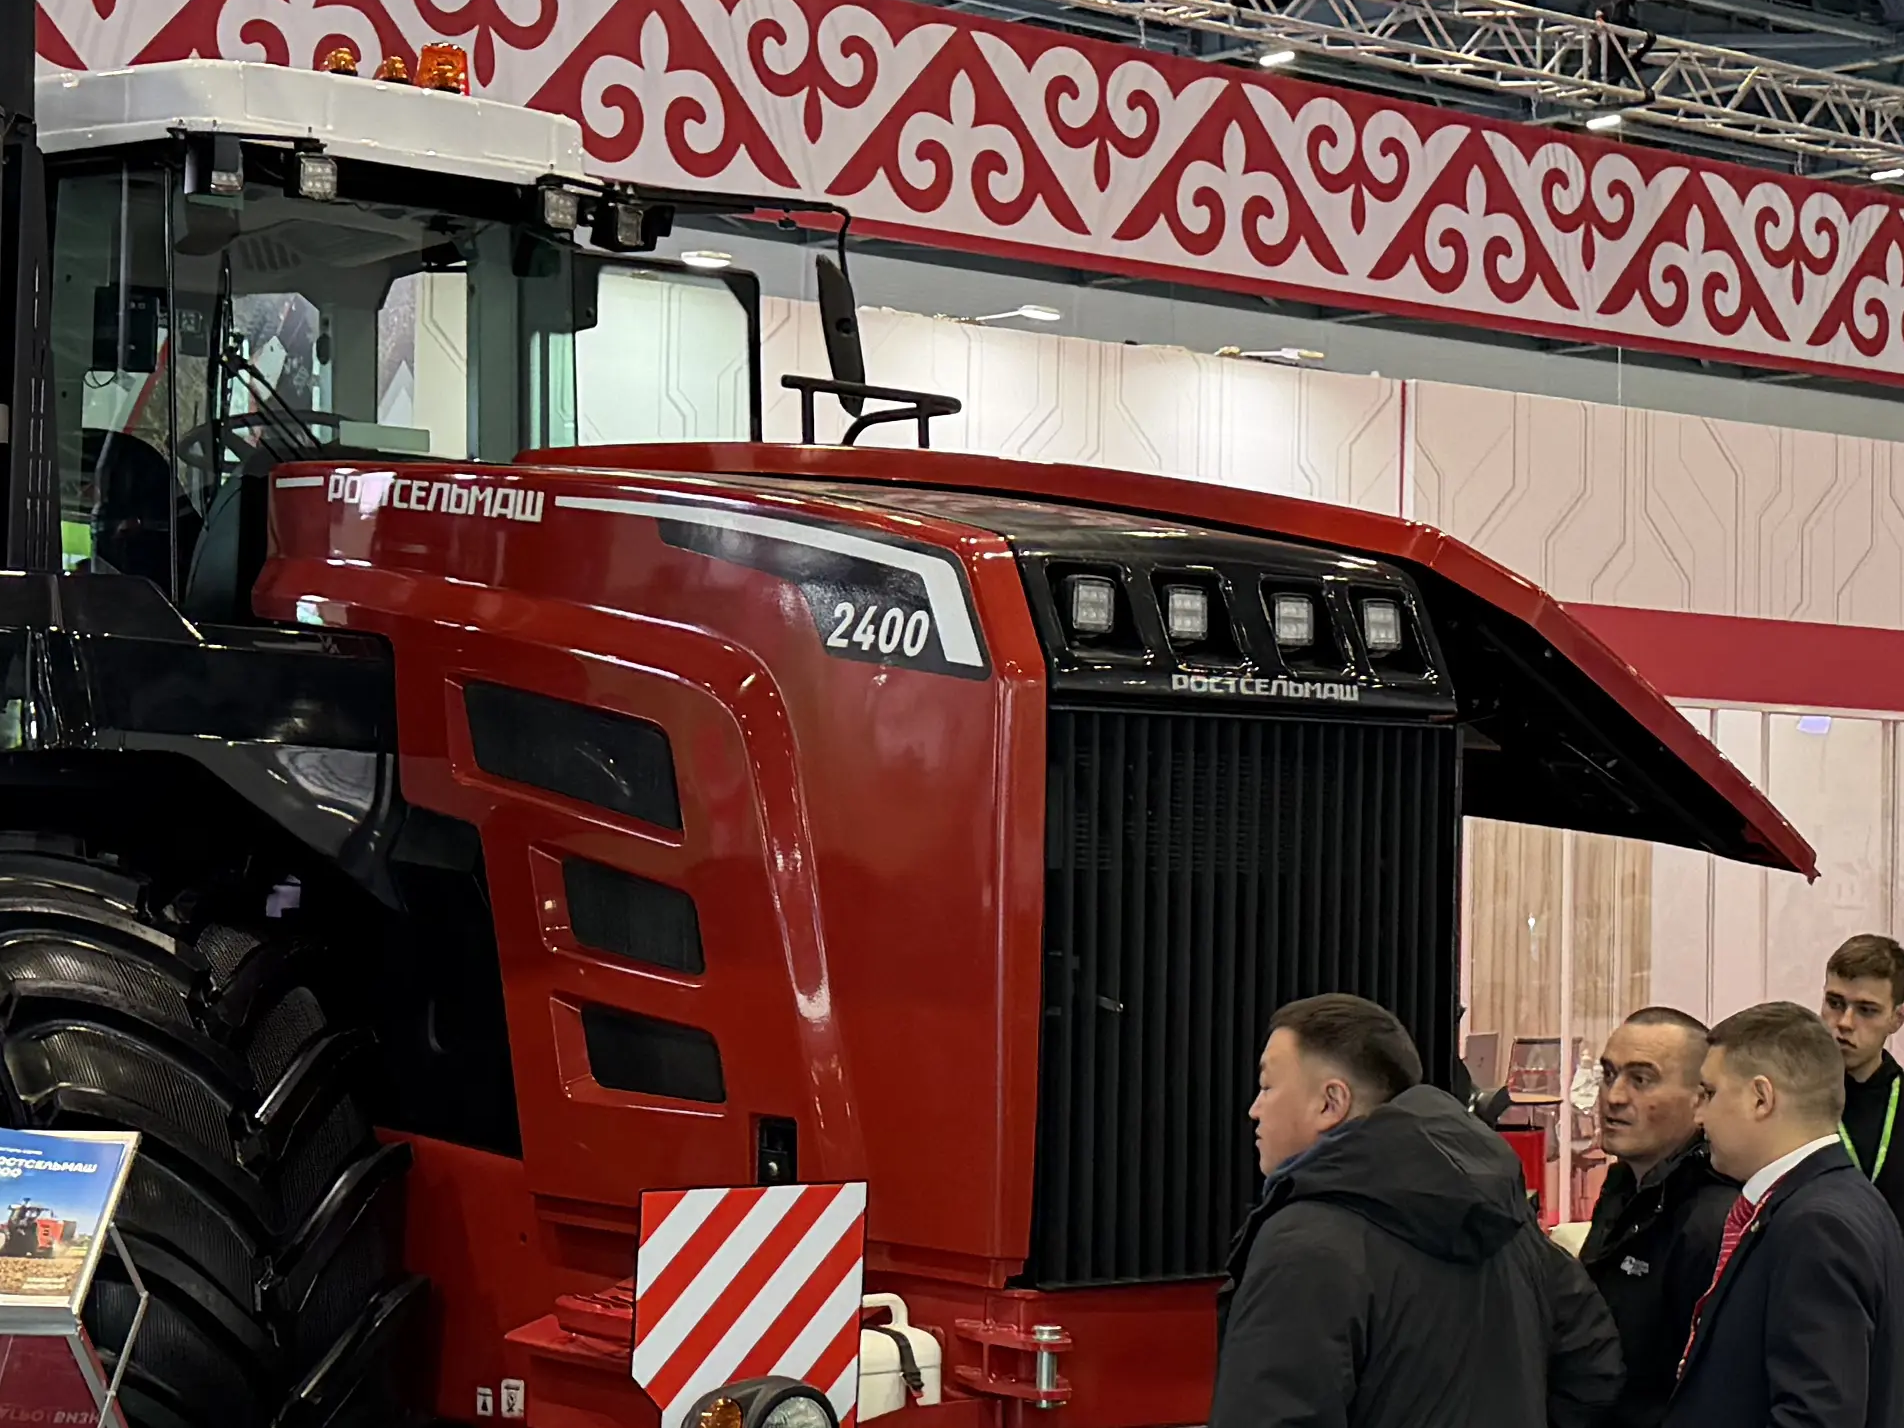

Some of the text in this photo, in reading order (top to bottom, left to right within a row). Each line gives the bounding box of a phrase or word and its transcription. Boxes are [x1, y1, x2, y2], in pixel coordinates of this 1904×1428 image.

[327, 471, 545, 524] РОСТСЕЛЬМАШ
[827, 601, 931, 659] 2400
[1171, 673, 1359, 702] РОСТСЕЛЬМАШ
